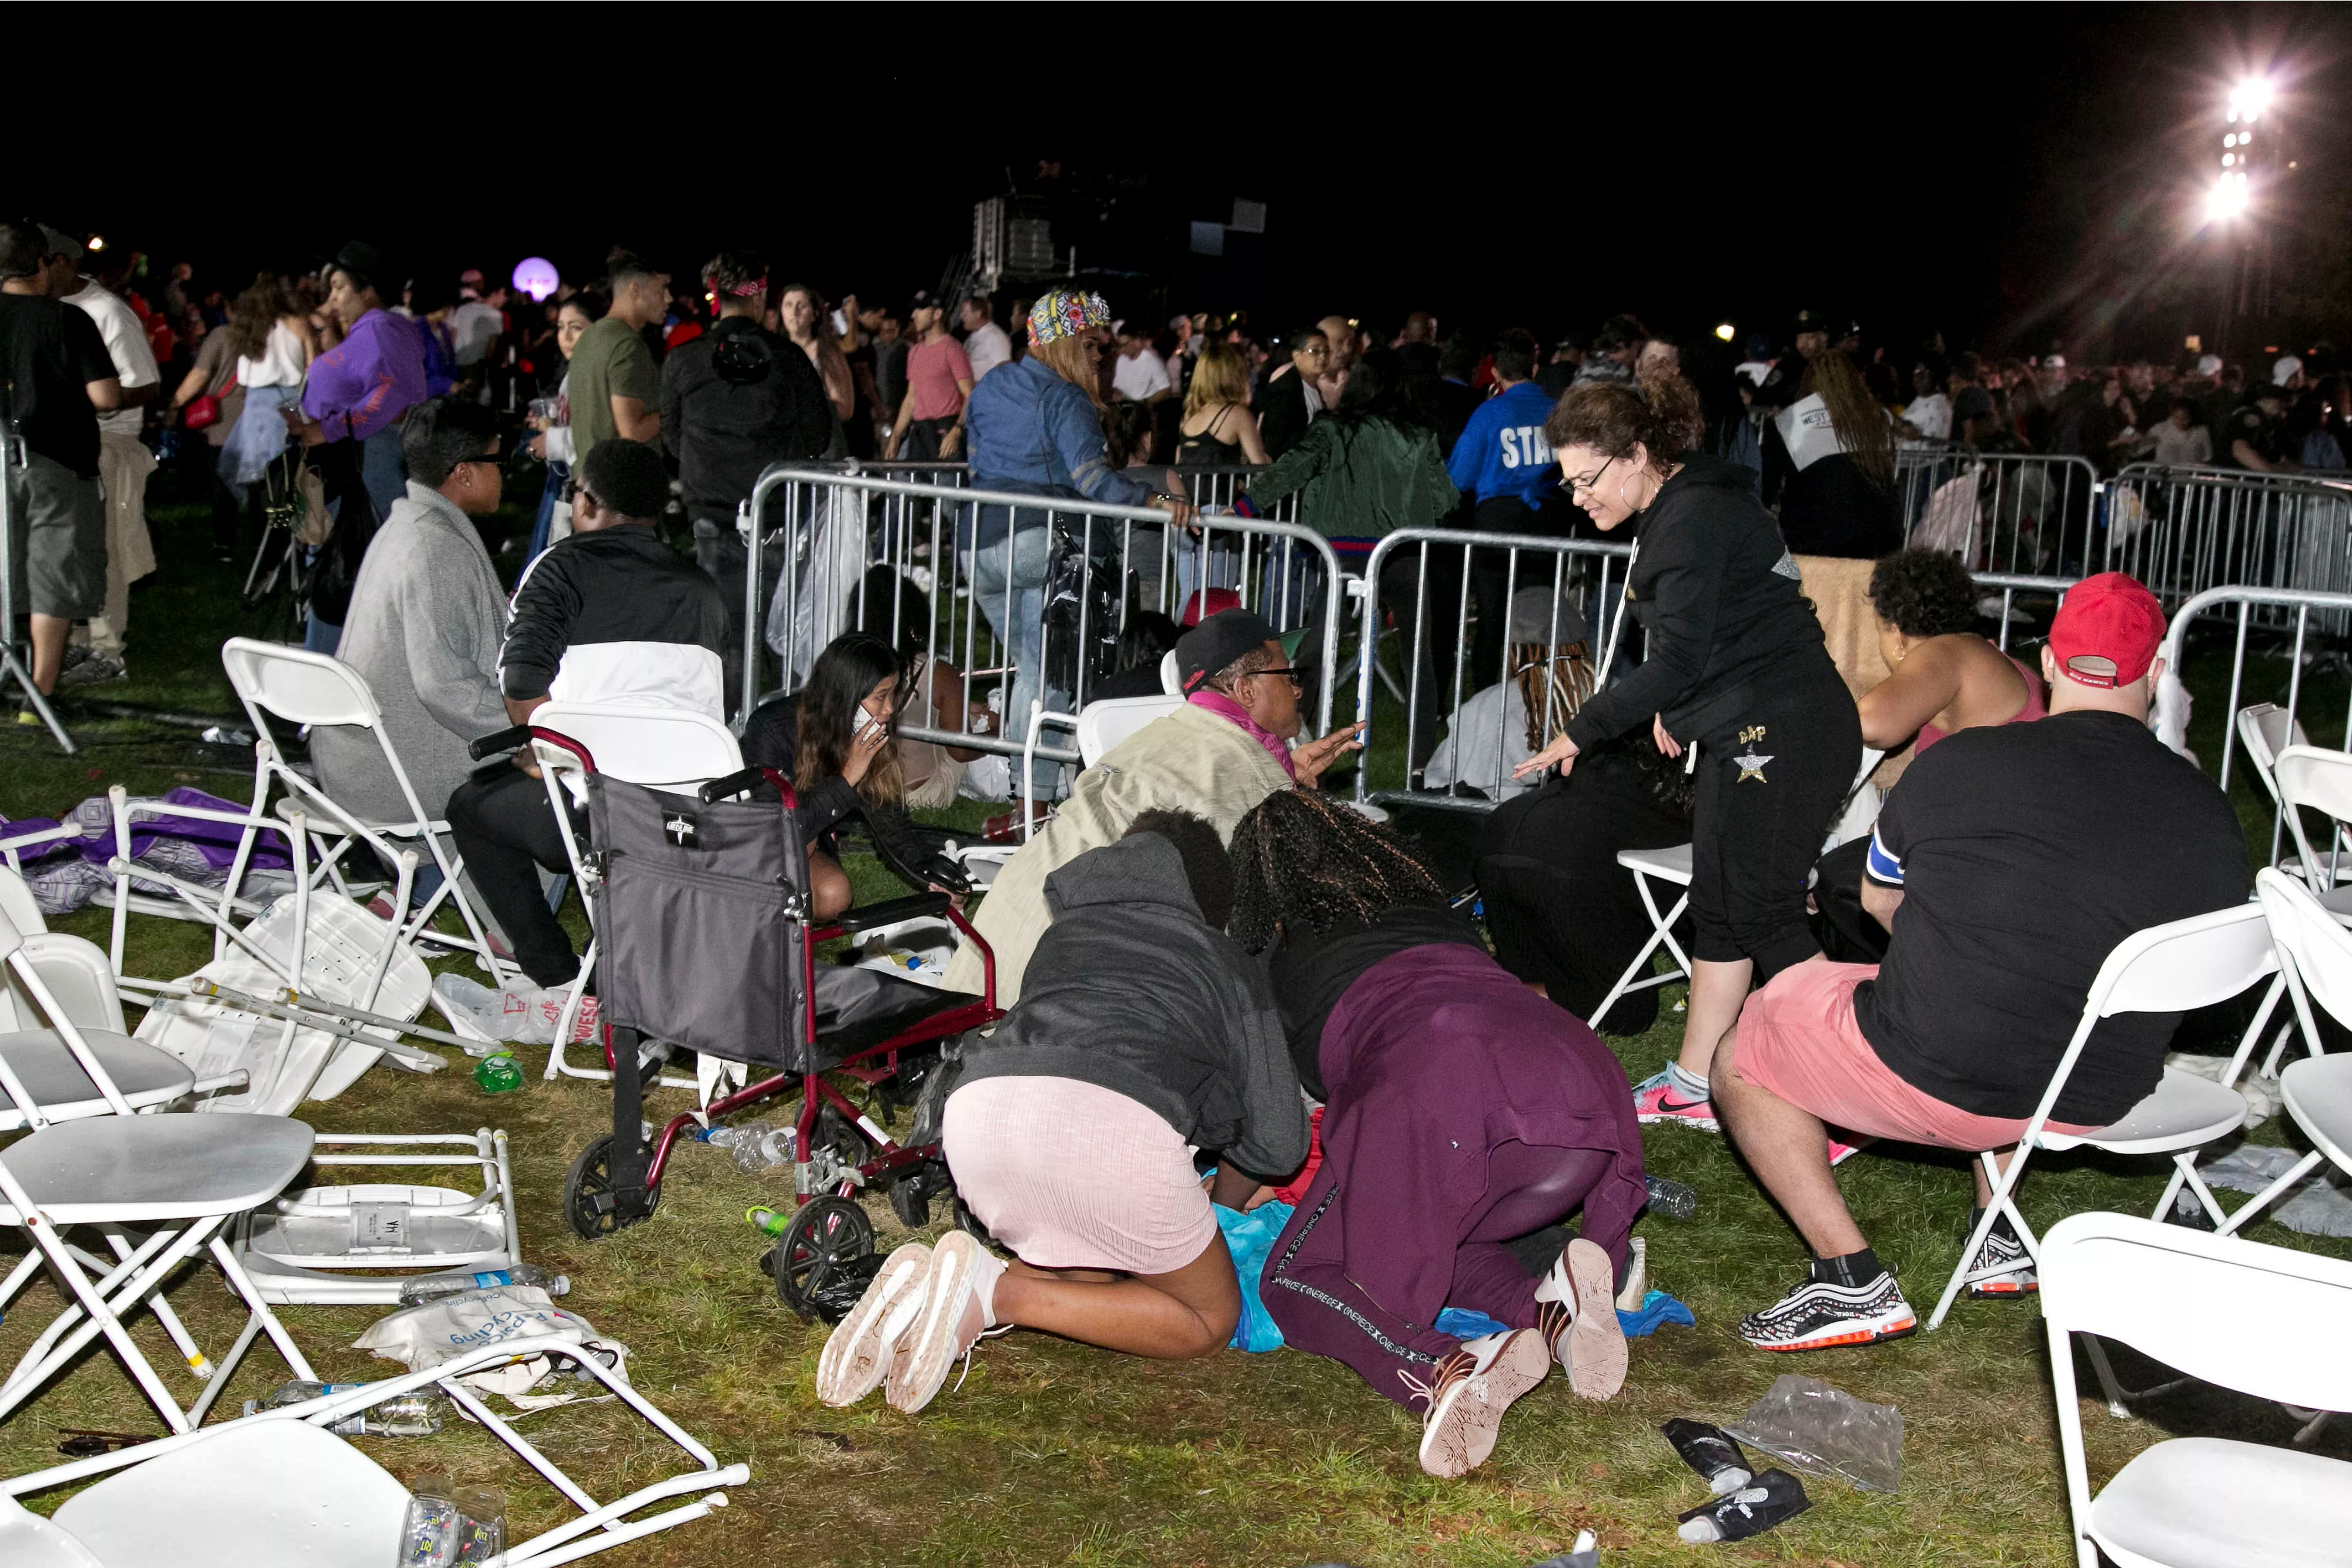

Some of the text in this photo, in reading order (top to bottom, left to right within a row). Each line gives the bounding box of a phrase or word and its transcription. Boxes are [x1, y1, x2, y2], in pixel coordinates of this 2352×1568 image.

[666, 821, 694, 834] MEDLINE
[1290, 1213, 1319, 1251] ONEPIECE
[1343, 1306, 1376, 1334] ONEPIECE
